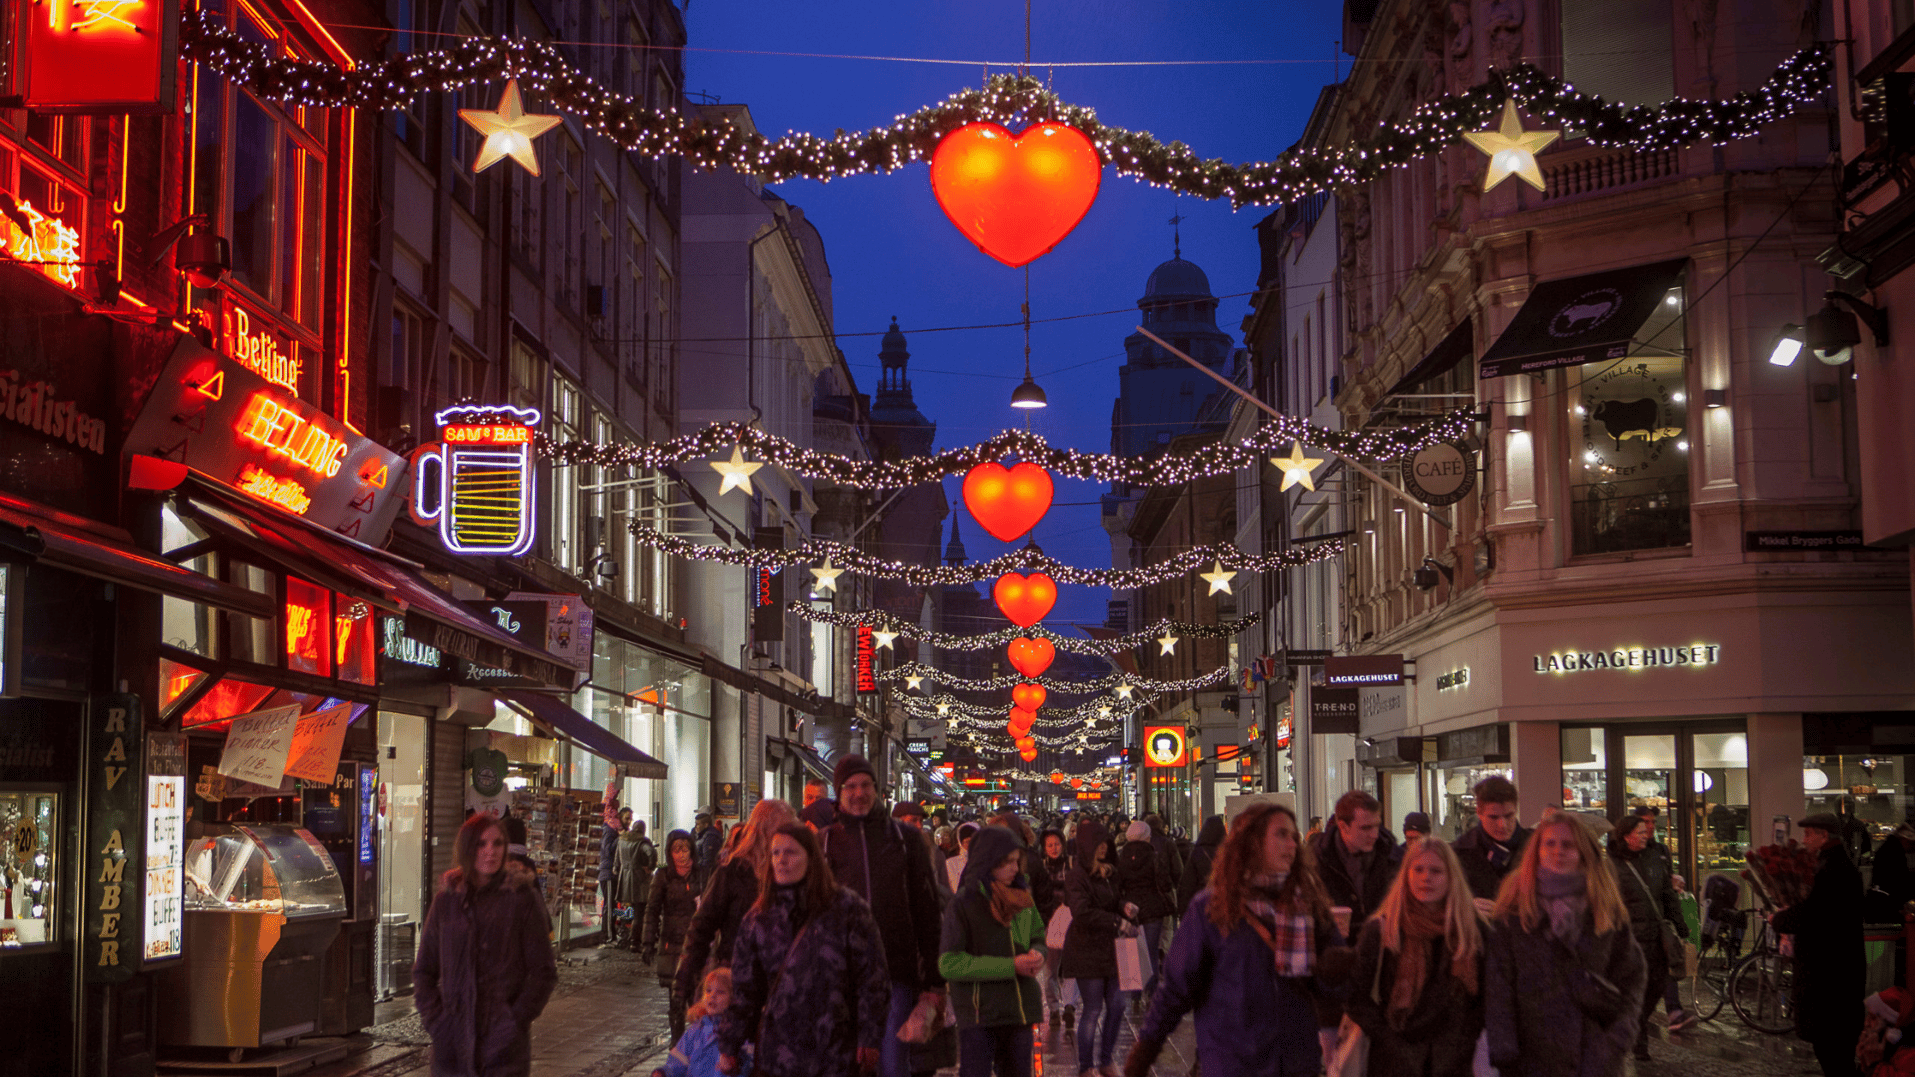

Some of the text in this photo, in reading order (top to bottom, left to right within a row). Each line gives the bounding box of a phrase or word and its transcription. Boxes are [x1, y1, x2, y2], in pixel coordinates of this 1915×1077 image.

[1521, 355, 1586, 370] HEREFORD VILLAGE
[1601, 366, 1650, 384] VILLAGE
[244, 398, 348, 478] BEIJING
[493, 427, 529, 442] BAR
[1415, 457, 1463, 478] CAFÉ
[1758, 535, 1861, 547] Mikkel Bryggers Gade
[858, 622, 878, 692] EWYORKER
[1533, 645, 1719, 673] LAGKAGEHUSET
[1330, 673, 1399, 683] LAGKAGEHUSET
[98, 829, 128, 966] AMBER
